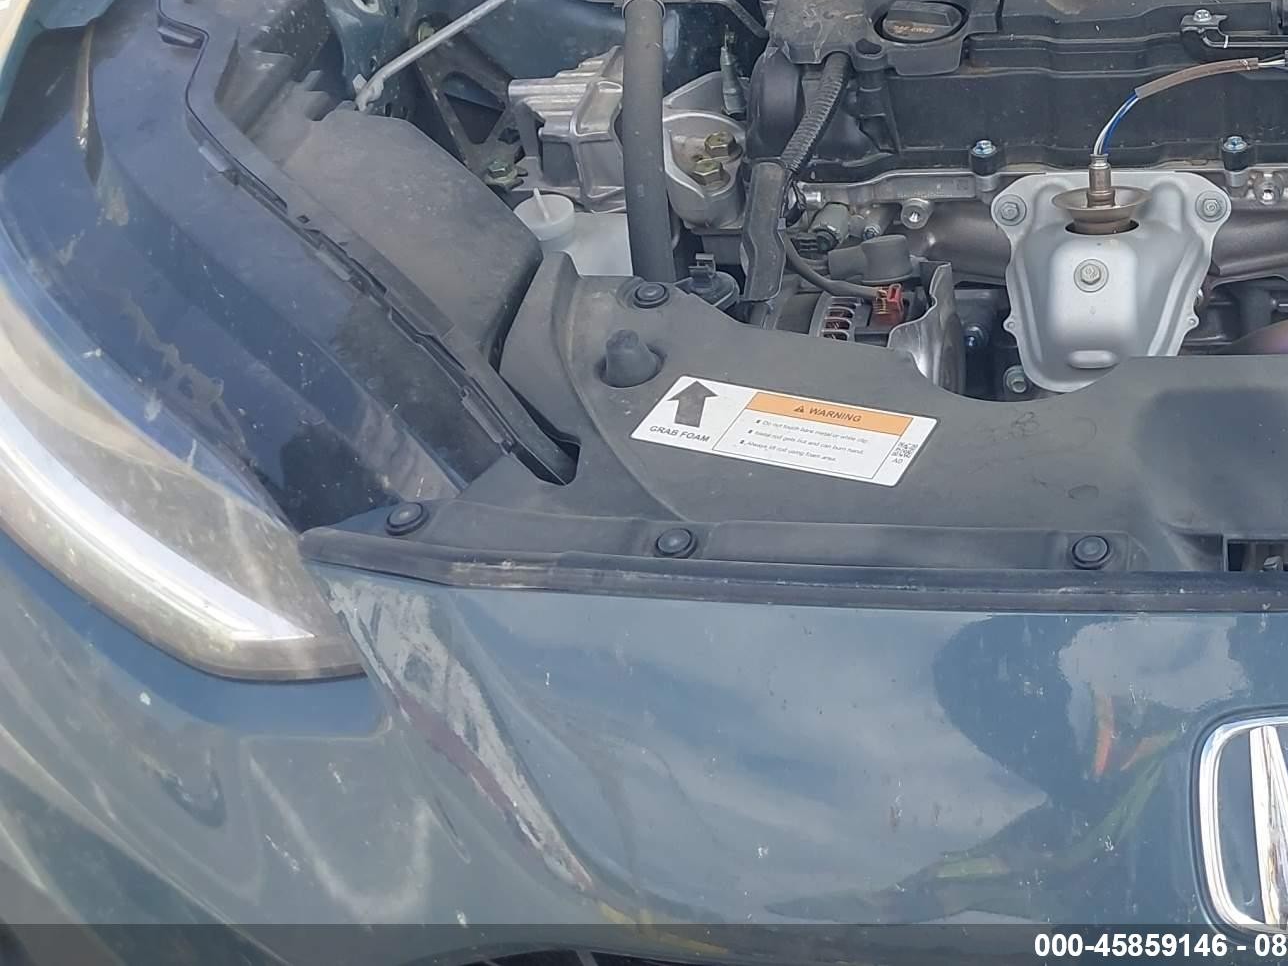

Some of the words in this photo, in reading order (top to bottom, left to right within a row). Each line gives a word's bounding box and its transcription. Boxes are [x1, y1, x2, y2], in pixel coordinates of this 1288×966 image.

[809, 407, 862, 423] WARNING
[649, 425, 679, 436] GRAB
[679, 431, 710, 442] FOAM
